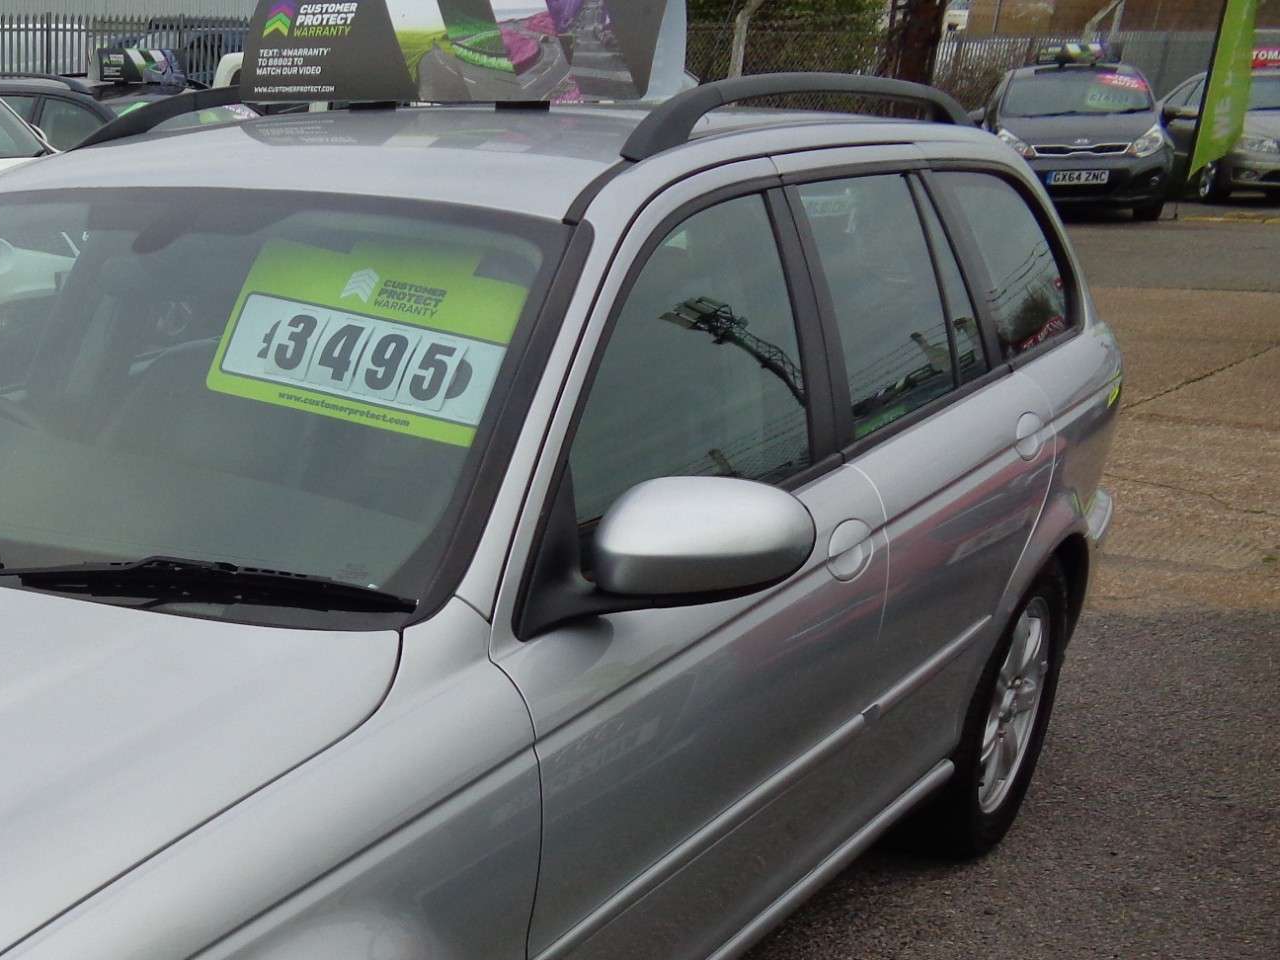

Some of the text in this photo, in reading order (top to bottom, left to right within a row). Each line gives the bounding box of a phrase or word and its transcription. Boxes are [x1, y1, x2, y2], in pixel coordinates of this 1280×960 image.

[300, 2, 358, 14] CUSTOMER
[296, 13, 355, 26] PROTECT
[293, 26, 352, 38] WARRANTY
[258, 58, 267, 66] TO
[294, 57, 304, 65] TO
[256, 66, 321, 76] WATCH OUR VIDEO
[384, 279, 447, 298] CUSTOMER
[379, 287, 443, 309] PROTECT
[374, 298, 438, 318] WARRANTY
[278, 391, 410, 428] www.customerprotect.com
